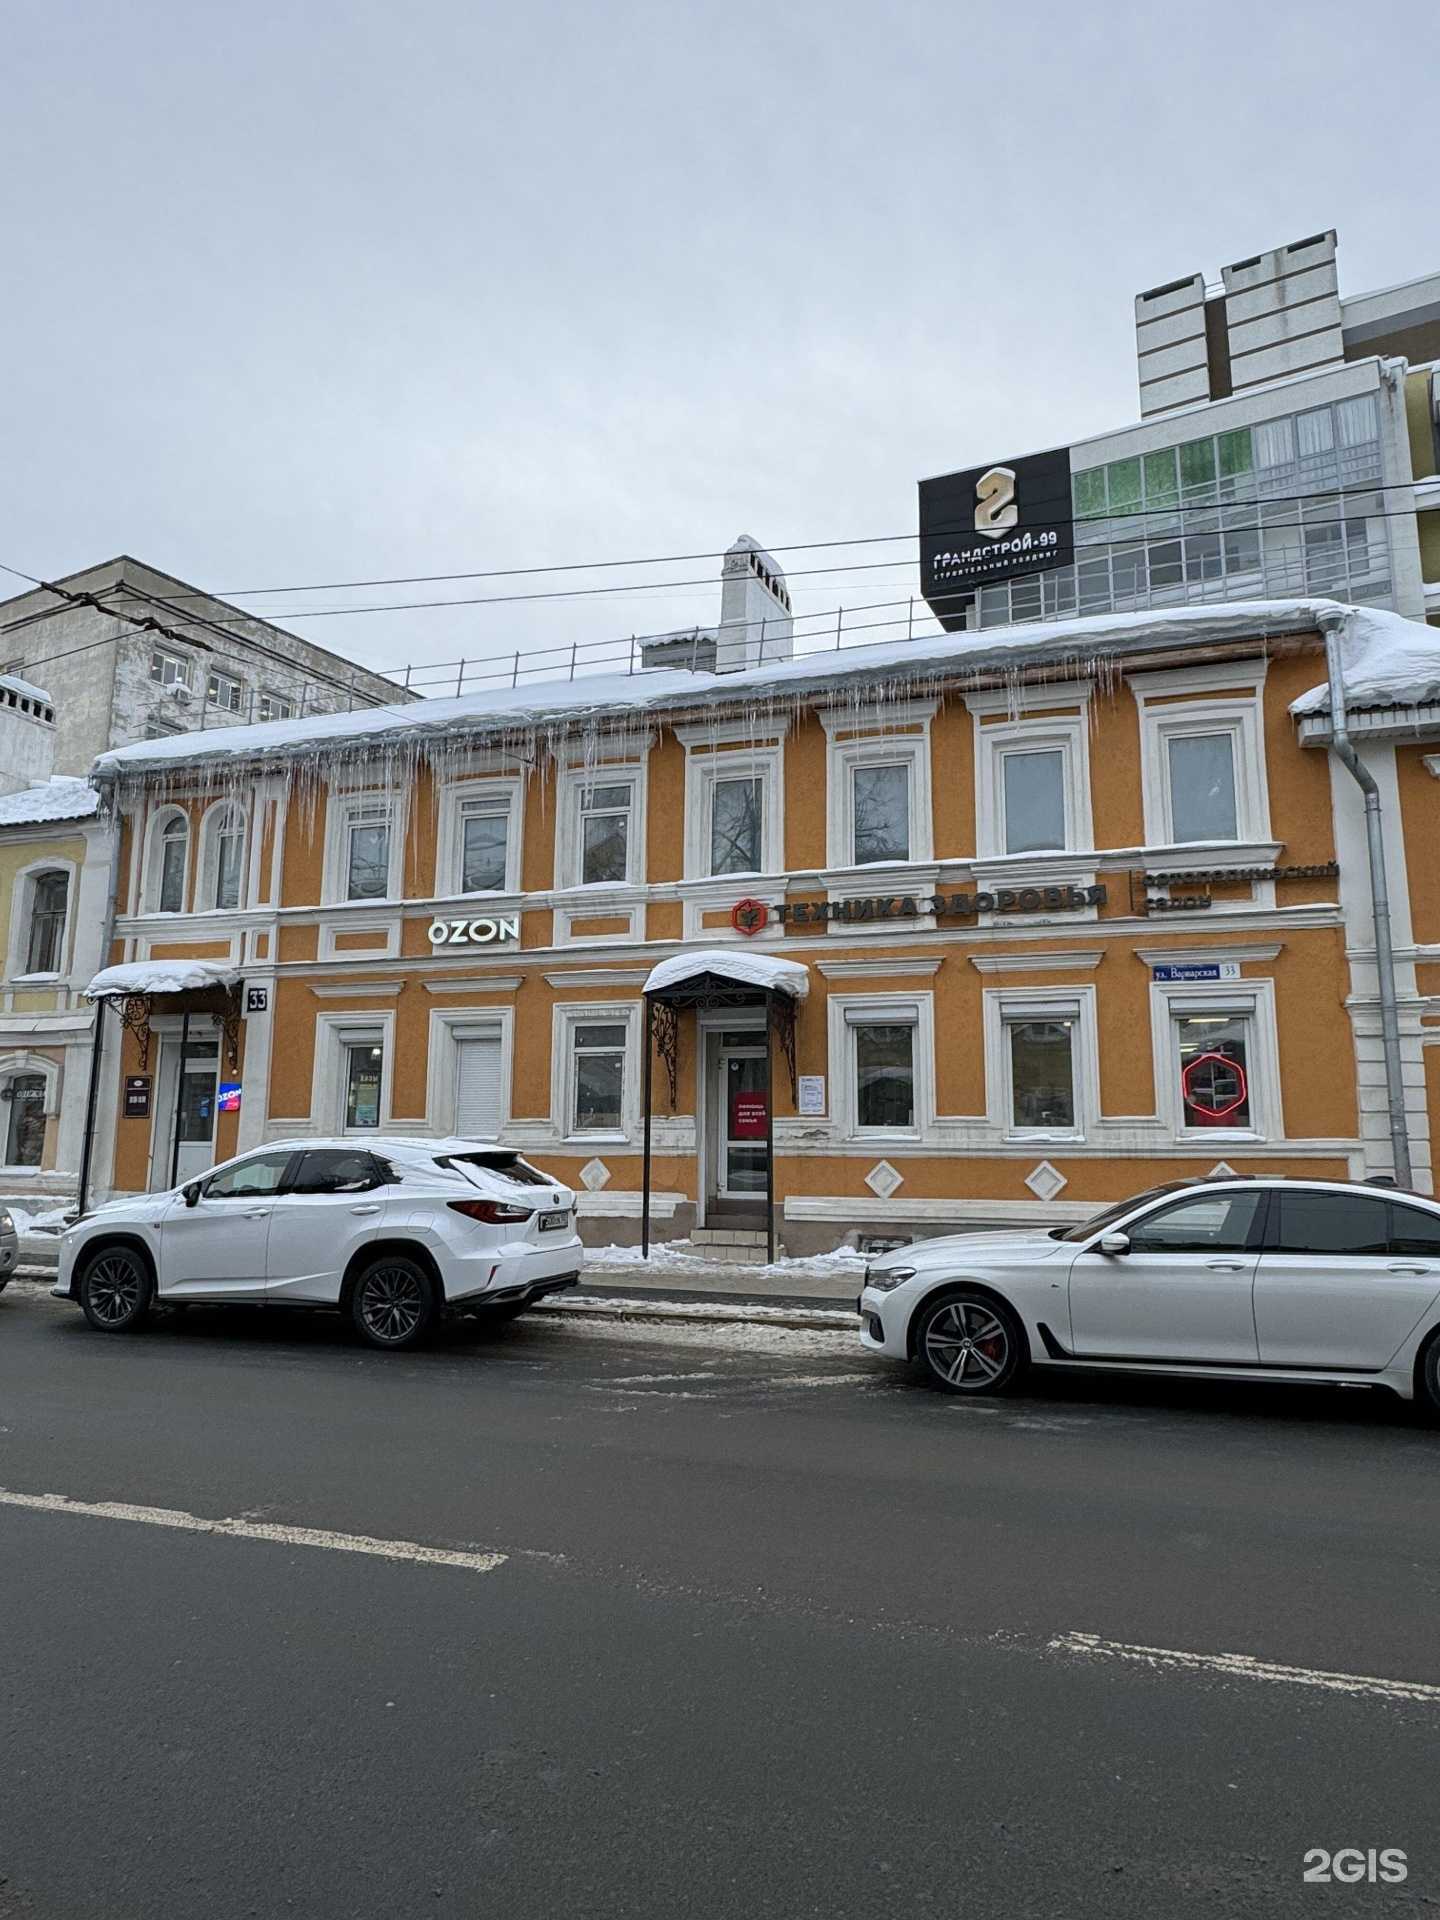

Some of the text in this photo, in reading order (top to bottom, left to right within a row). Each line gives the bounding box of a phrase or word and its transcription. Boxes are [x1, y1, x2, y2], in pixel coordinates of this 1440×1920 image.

[772, 883, 1108, 925] ТЕХНИКА ЗДОРОВЬЯ
[428, 917, 519, 945] OZON
[249, 990, 268, 1009] 33
